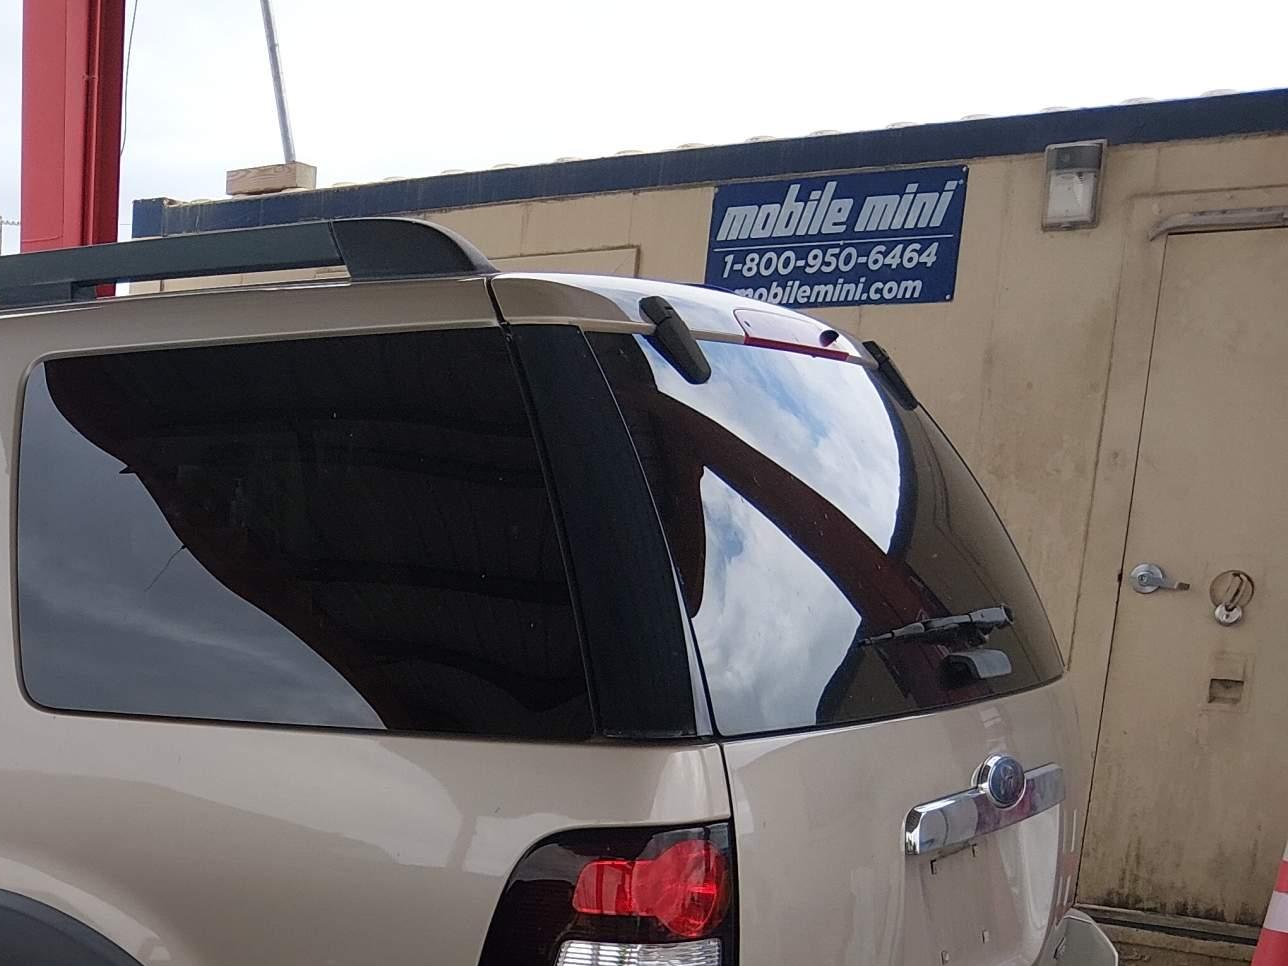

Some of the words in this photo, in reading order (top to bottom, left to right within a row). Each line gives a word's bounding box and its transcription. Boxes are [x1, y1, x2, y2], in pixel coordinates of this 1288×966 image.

[716, 181, 854, 241] mobile
[854, 180, 958, 232] mini
[722, 242, 939, 278] 1-800-950-6464
